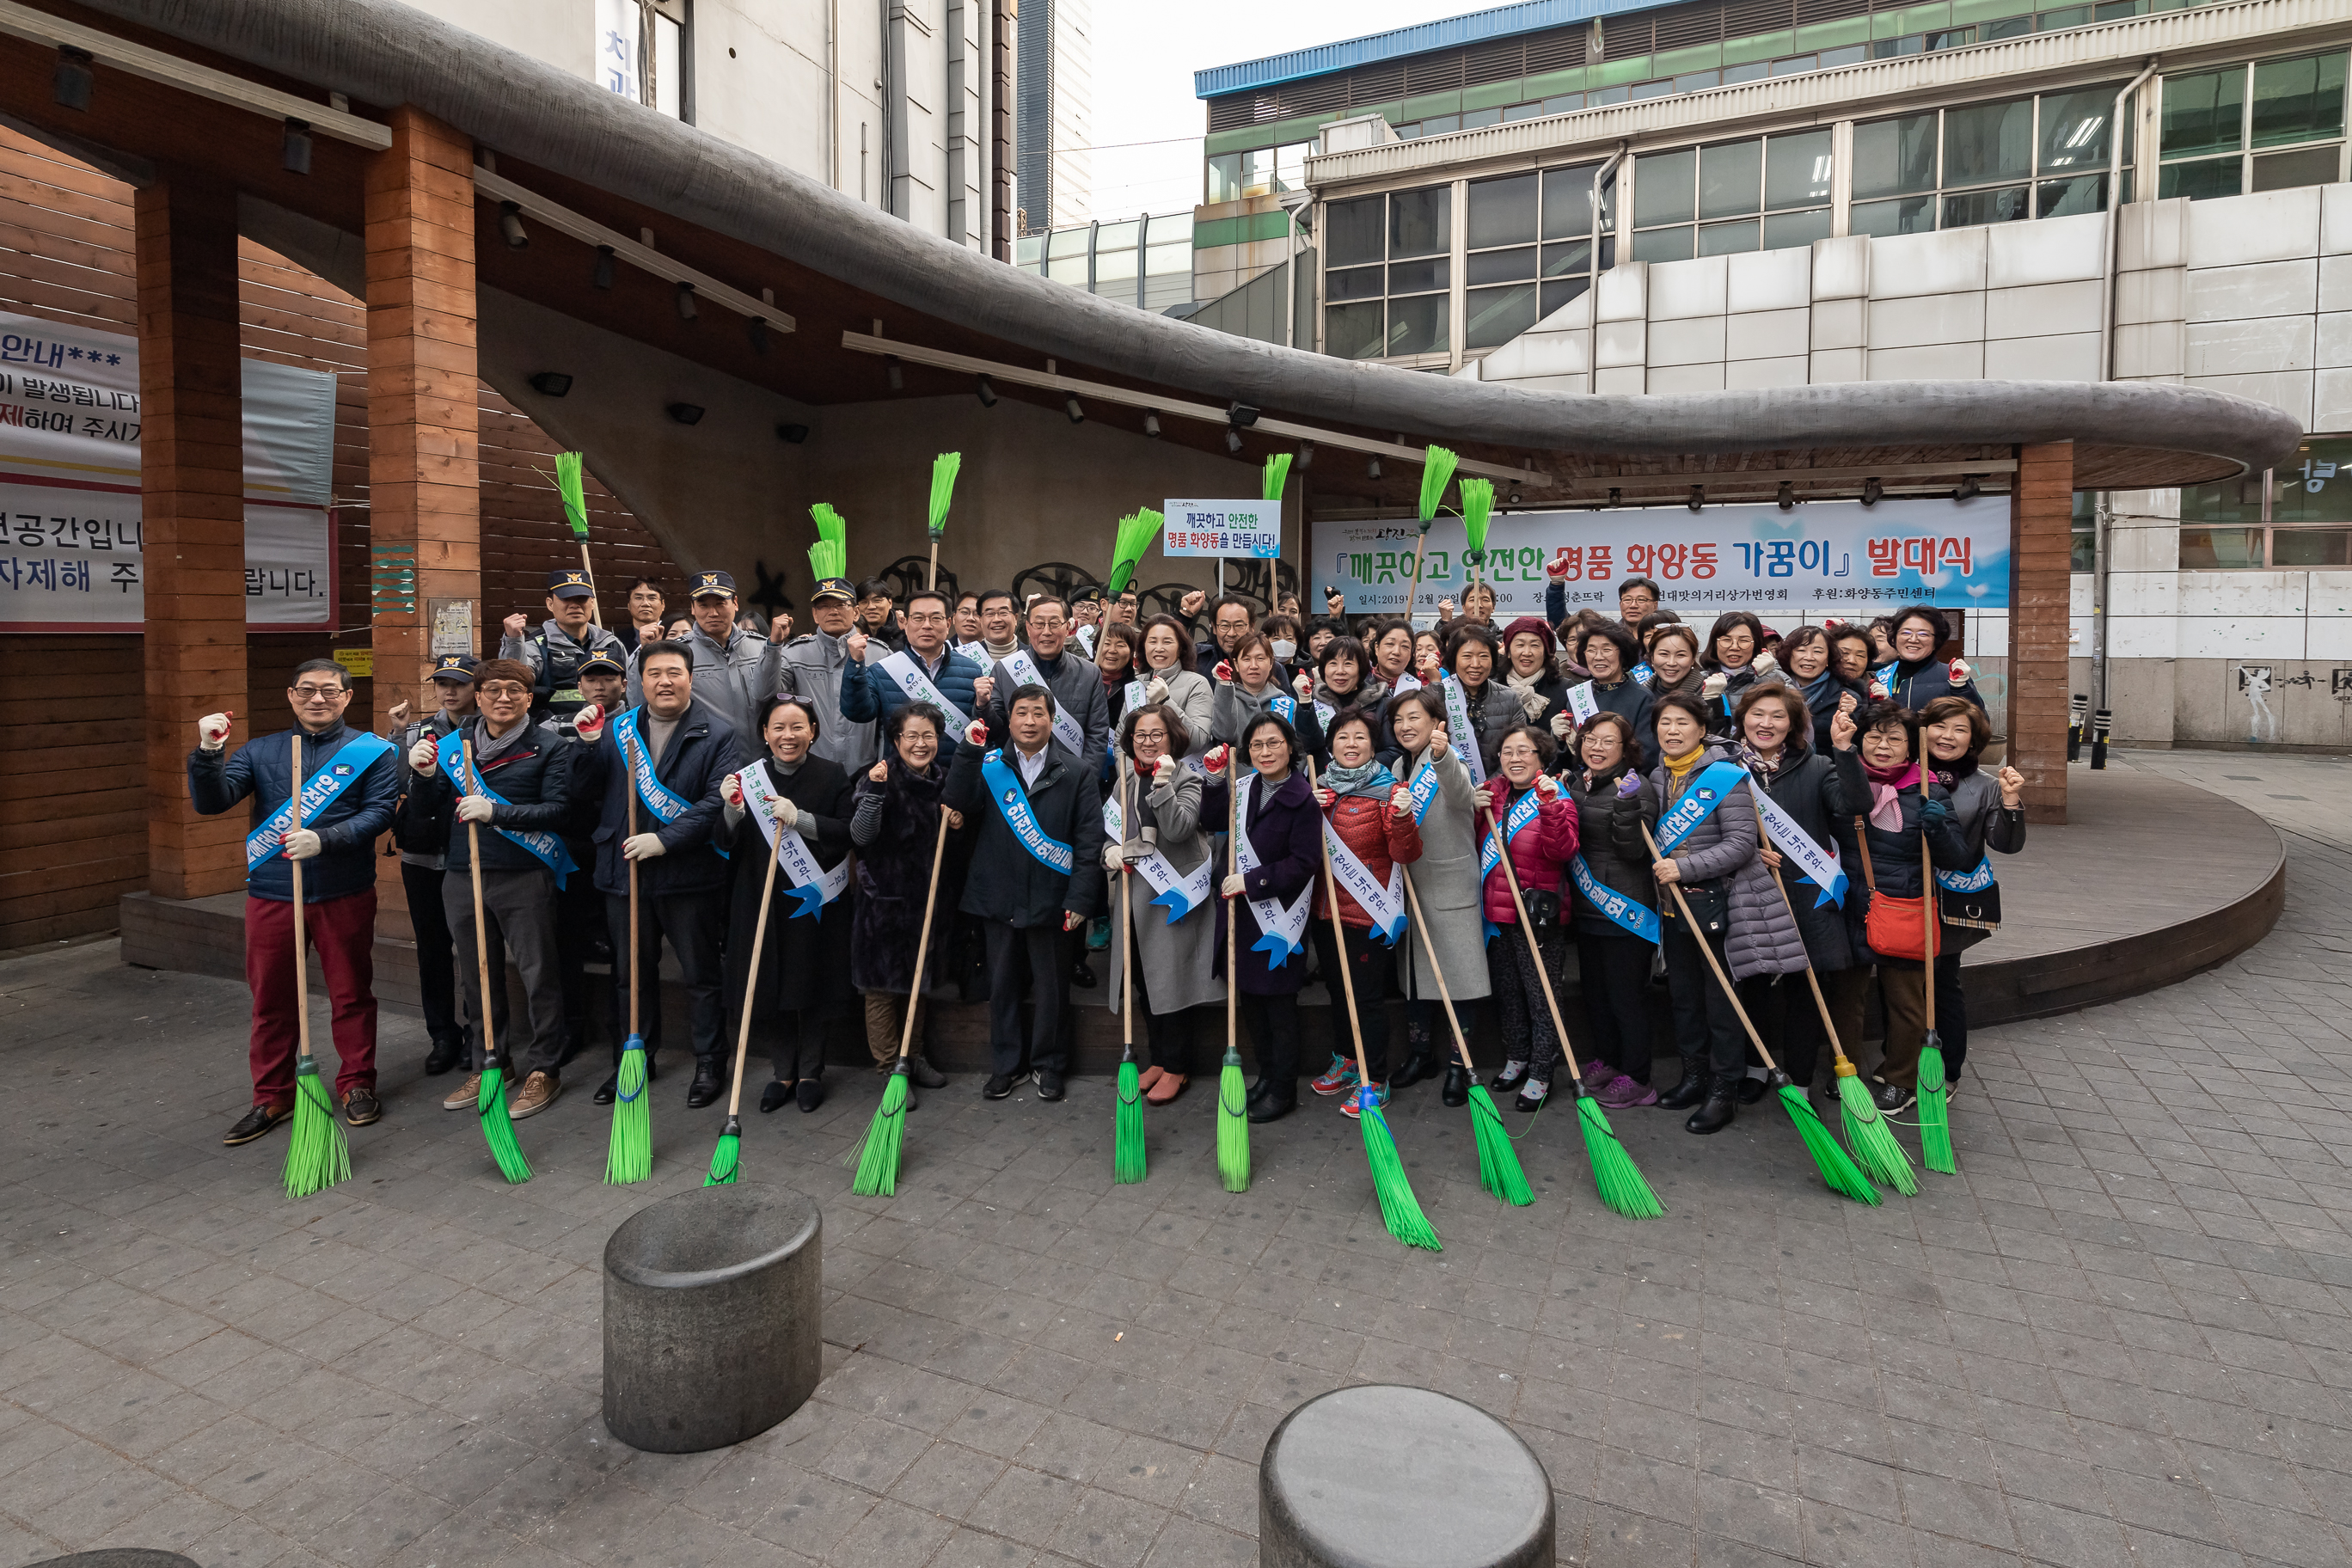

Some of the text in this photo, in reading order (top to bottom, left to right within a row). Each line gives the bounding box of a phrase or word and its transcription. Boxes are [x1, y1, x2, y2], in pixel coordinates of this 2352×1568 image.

[604, 30, 635, 99] 치과
[22, 377, 139, 413] 발생됩니다
[1186, 512, 1259, 530] 깨끗하고 안전한
[1168, 531, 1275, 549] 명품 화양동을 만듭시다!
[1375, 527, 1407, 541] 광진
[1461, 547, 1545, 582] 안전한
[1556, 545, 1613, 582] 명품
[1626, 543, 1718, 579] 화양동
[1868, 536, 1971, 576] 발대식
[0, 557, 89, 592] 자제해
[1358, 594, 1414, 605] 일시:2019
[1418, 594, 1434, 604] 2월
[1811, 587, 1936, 601] 후원:화양동주민센터
[1014, 664, 1032, 677] 광진구
[907, 676, 923, 692] 광진구
[952, 720, 963, 732] 앞
[1452, 714, 1465, 731] 점포
[1455, 732, 1467, 741] 앞
[754, 789, 769, 807] 점포
[781, 840, 799, 859] 내가
[793, 858, 812, 882] 해요!
[1764, 813, 1792, 838] 청소는
[1787, 835, 1806, 853] 내가
[1804, 850, 1827, 873] 해요!
[1149, 862, 1170, 885] 해요!
[1334, 854, 1359, 879] 청소는
[1354, 876, 1372, 895] 내가
[1369, 891, 1389, 915] 해요!
